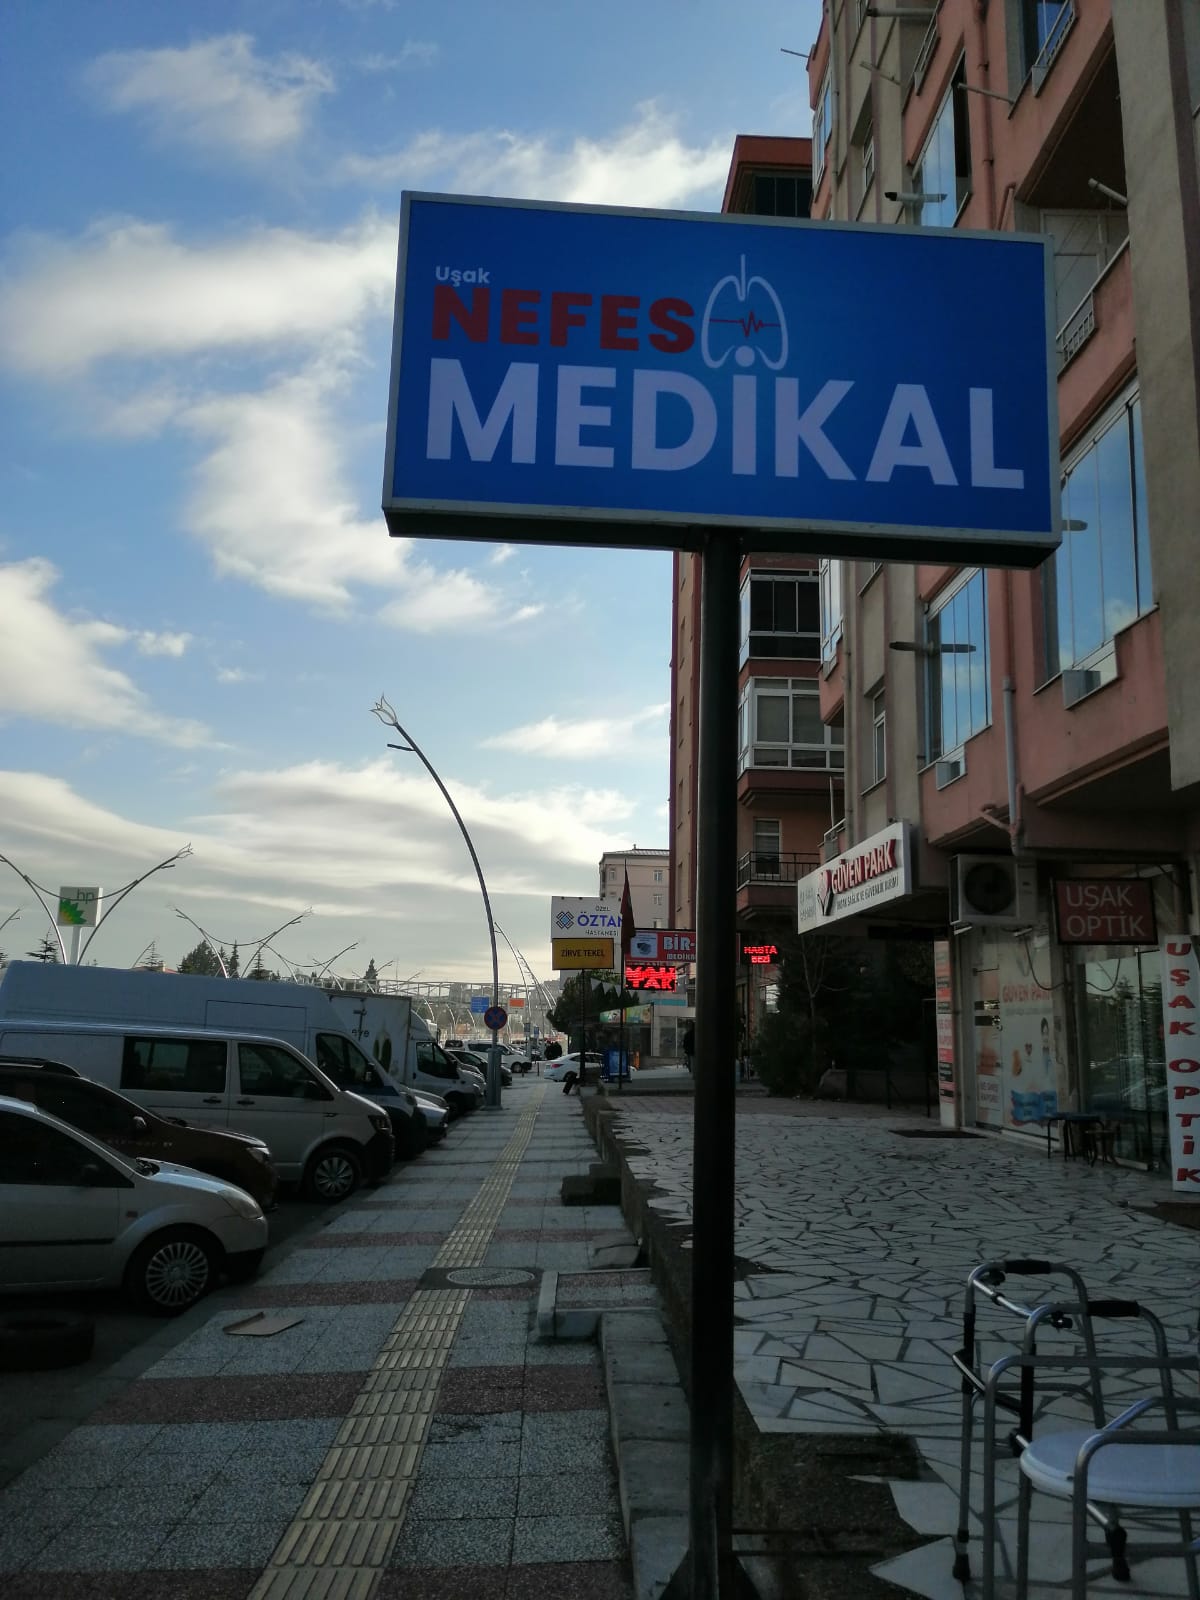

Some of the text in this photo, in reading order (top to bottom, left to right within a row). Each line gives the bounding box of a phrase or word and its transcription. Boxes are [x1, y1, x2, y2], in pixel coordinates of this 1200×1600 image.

[434, 265, 491, 286] Uşak
[431, 285, 696, 353] NEFES
[426, 357, 1025, 490] MEDİKAL
[832, 838, 897, 894] GÜVEN PARK
[1065, 884, 1134, 911] UŞAK
[1066, 910, 1146, 937] OPTİK
[561, 948, 583, 957] ZİRVE
[1166, 942, 1197, 1036] UŞAK
[1168, 1058, 1200, 1183] OPTİK
